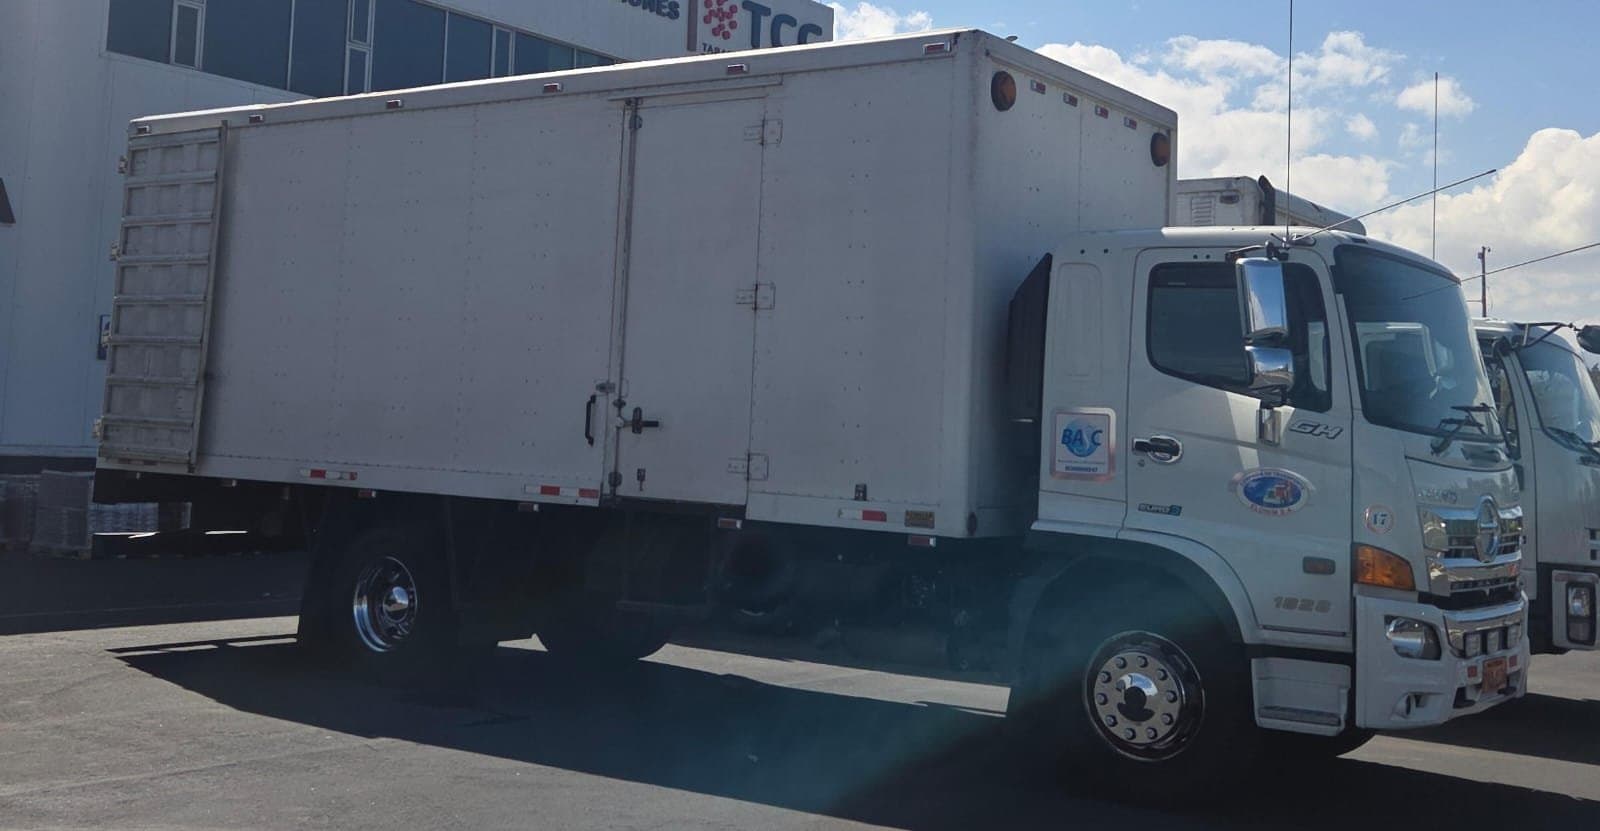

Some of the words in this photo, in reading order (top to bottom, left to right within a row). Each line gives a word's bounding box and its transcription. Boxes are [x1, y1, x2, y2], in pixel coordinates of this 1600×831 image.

[1061, 428, 1104, 447] BASC
[1289, 420, 1344, 440] GH
[1373, 511, 1389, 526] 17
